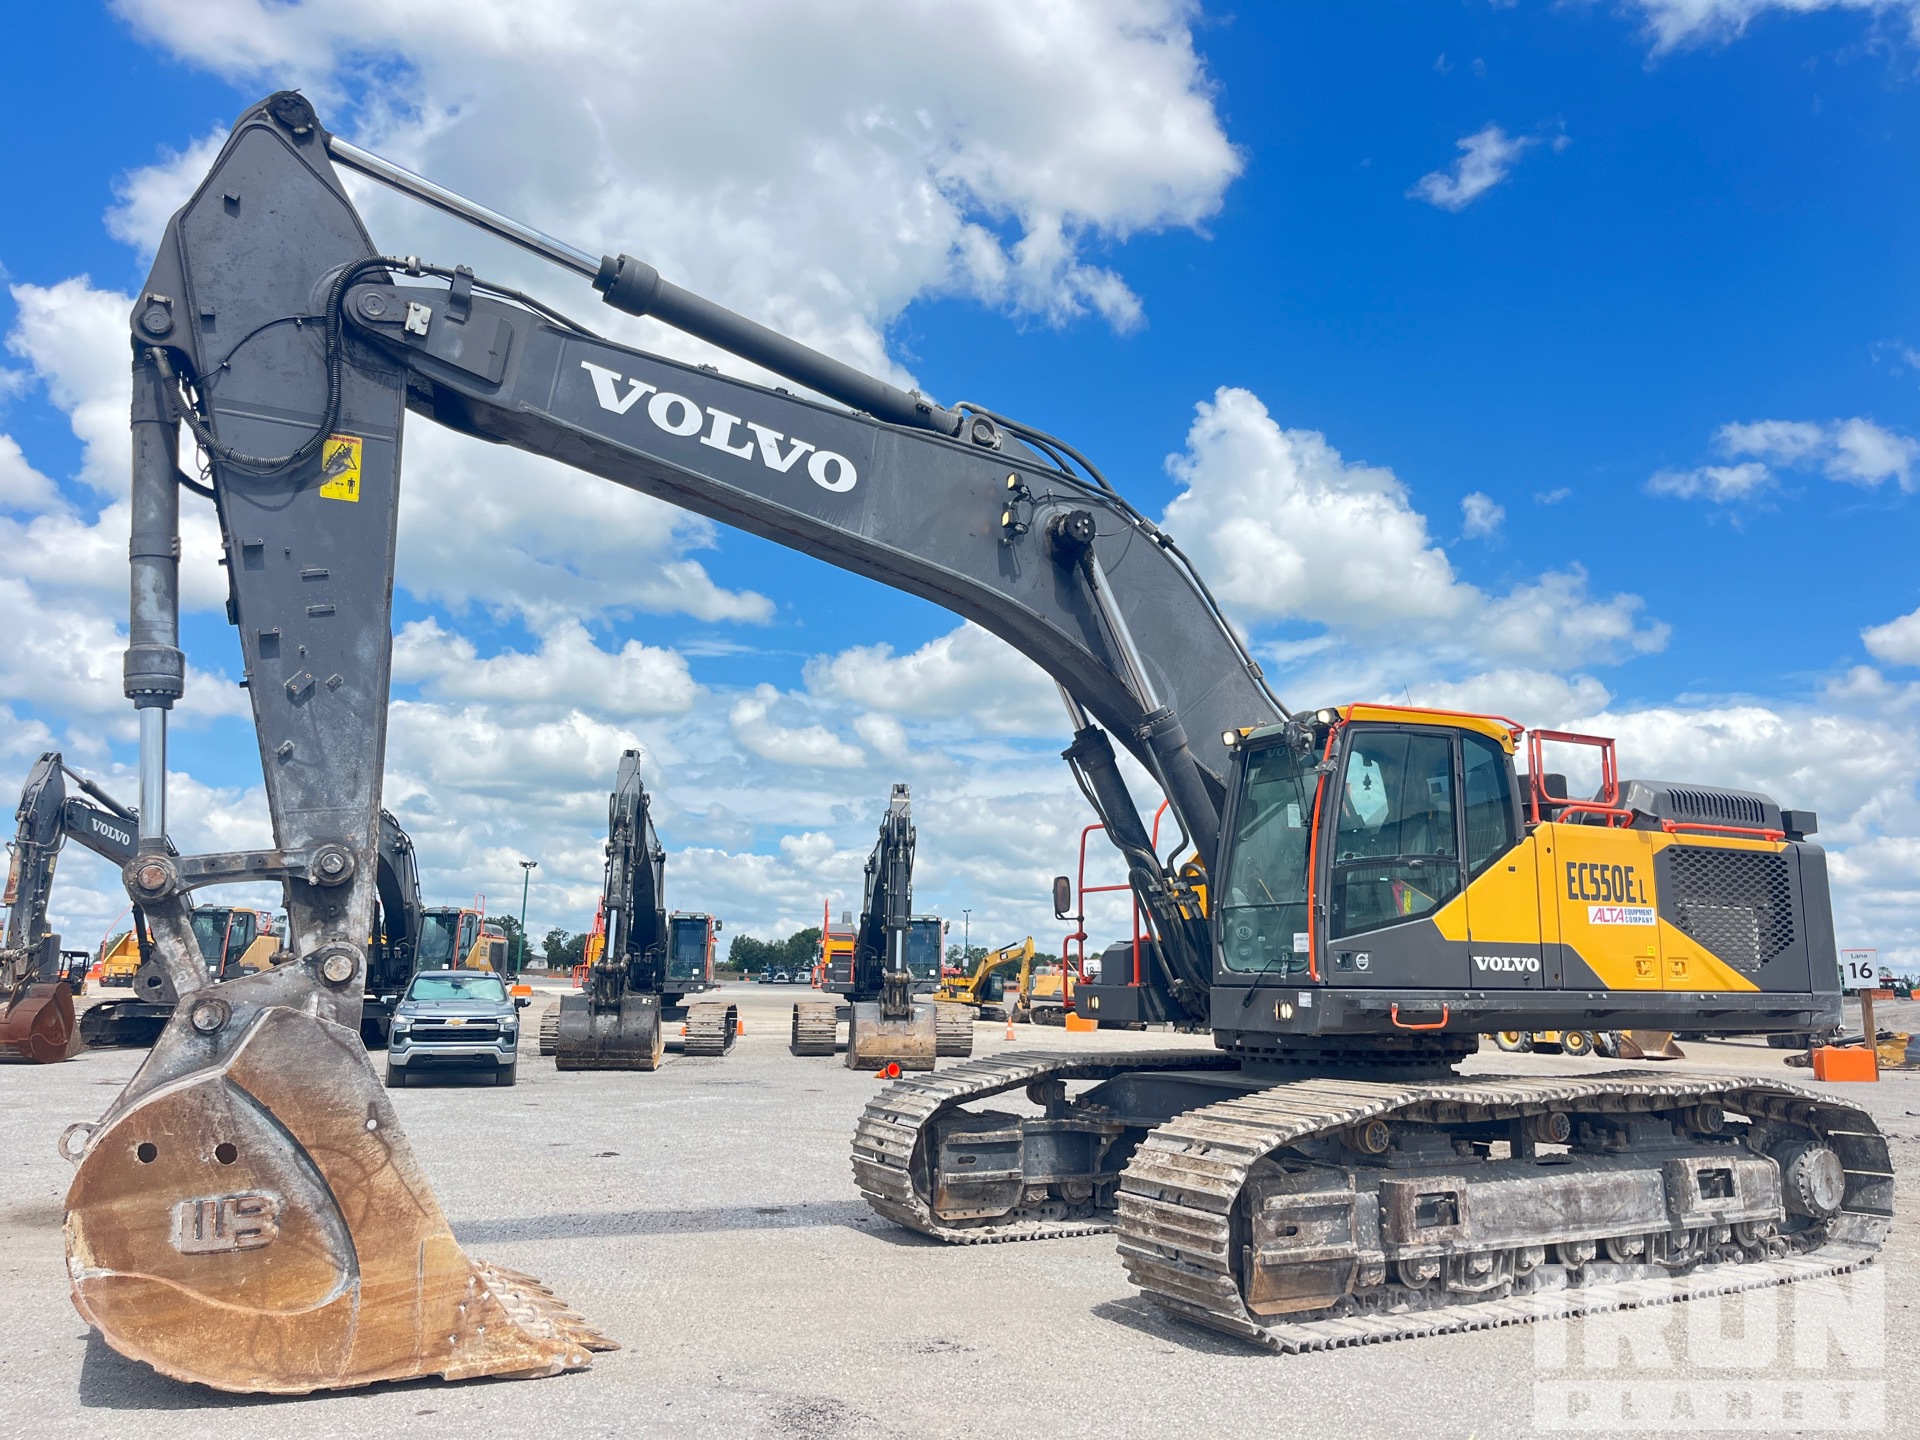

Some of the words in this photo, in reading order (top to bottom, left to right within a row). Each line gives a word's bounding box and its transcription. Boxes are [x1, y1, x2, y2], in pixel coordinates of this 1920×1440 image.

[580, 360, 858, 493] VOLVO
[91, 817, 131, 846] VOLVO
[1566, 861, 1637, 903] EC550E
[1591, 907, 1625, 923] ALTA
[1624, 908, 1652, 916] EQUIPMENT
[1624, 916, 1653, 924] COMPANY
[1473, 956, 1540, 973] VOLVO
[1849, 962, 1873, 979] 16
